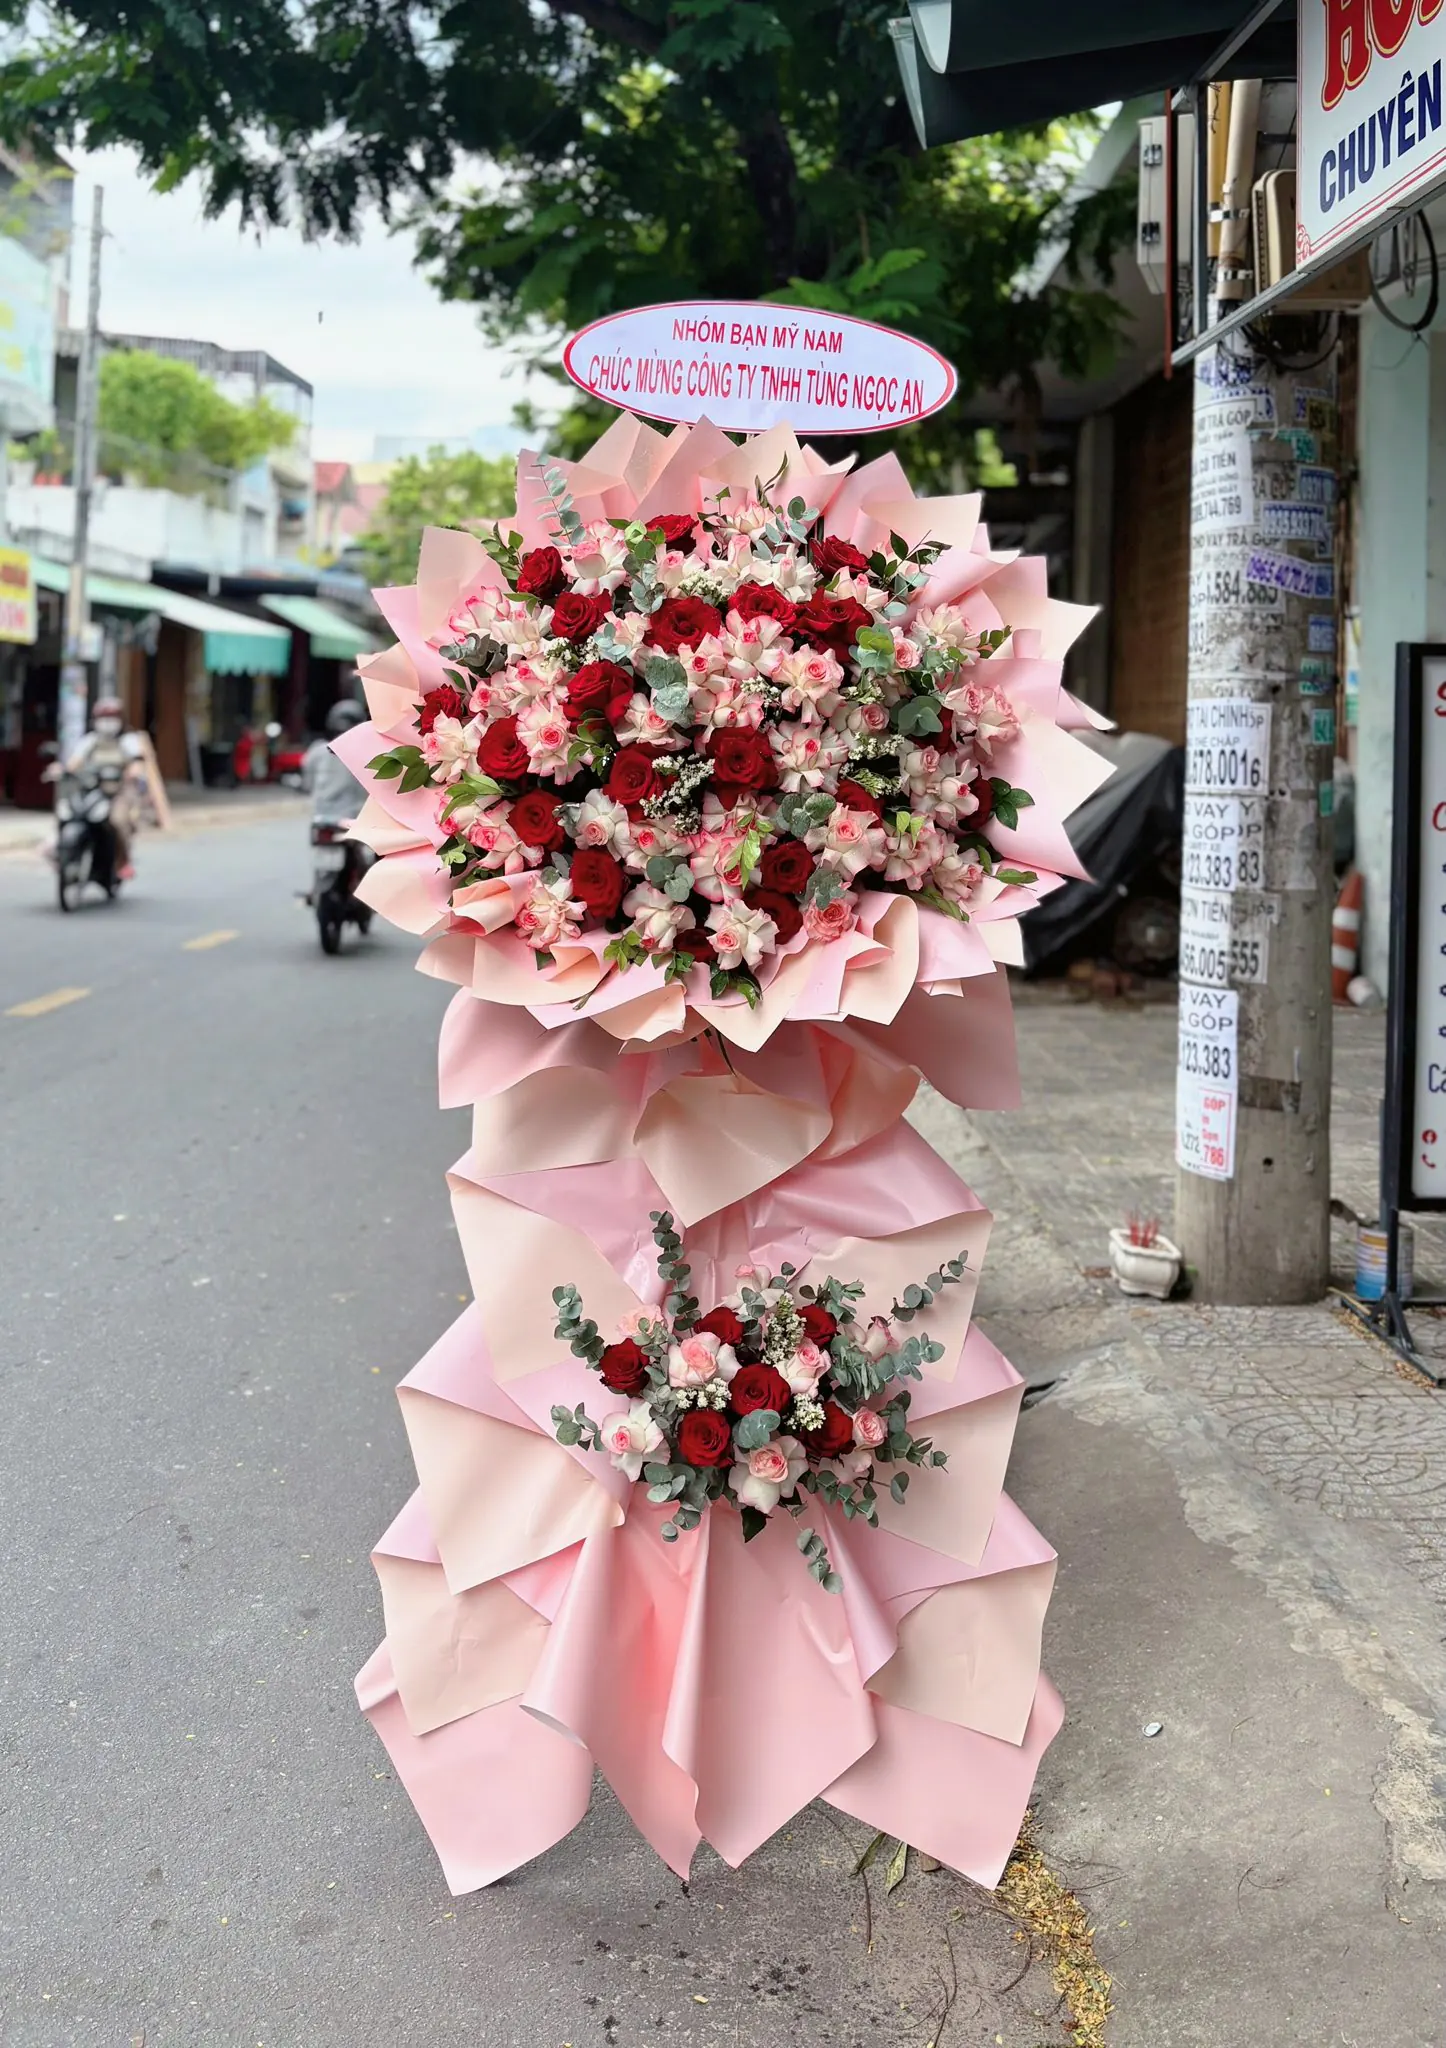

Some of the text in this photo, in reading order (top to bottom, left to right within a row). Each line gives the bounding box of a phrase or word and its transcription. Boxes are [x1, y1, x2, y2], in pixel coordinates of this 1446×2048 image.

[1319, 59, 1442, 213] CHUYÊN
[673, 313, 843, 353] NHÓM BẠN MỸ NAM
[588, 346, 923, 420] CHÚC MỪNG CÔNG TY TNHH TÙNG NGỌC AN
[1194, 802, 1230, 819] VAY
[1193, 821, 1235, 841] GÓP
[1189, 990, 1228, 1009] VAY
[1188, 1011, 1233, 1032] GÓP
